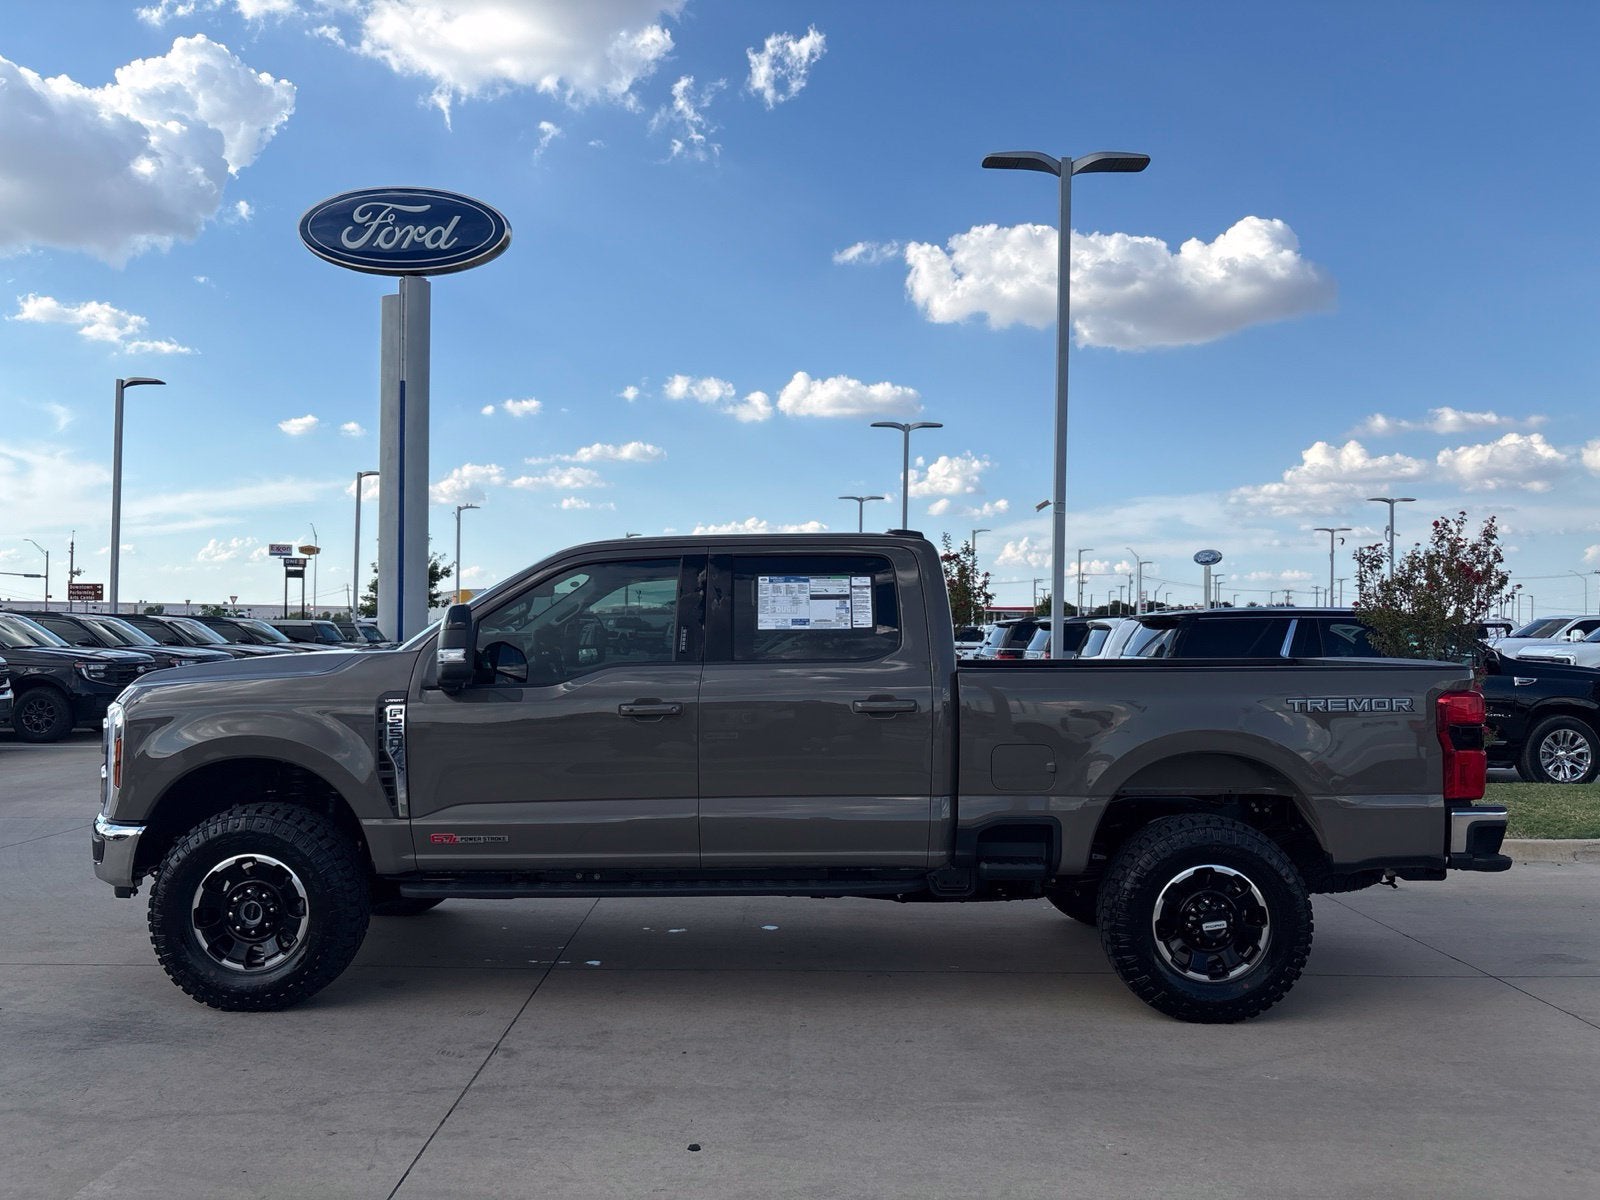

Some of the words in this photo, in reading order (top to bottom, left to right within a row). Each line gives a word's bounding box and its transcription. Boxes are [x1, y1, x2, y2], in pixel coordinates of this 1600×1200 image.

[341, 202, 461, 250] Ford
[270, 544, 292, 553] Exxon
[1286, 697, 1415, 713] TREMOR
